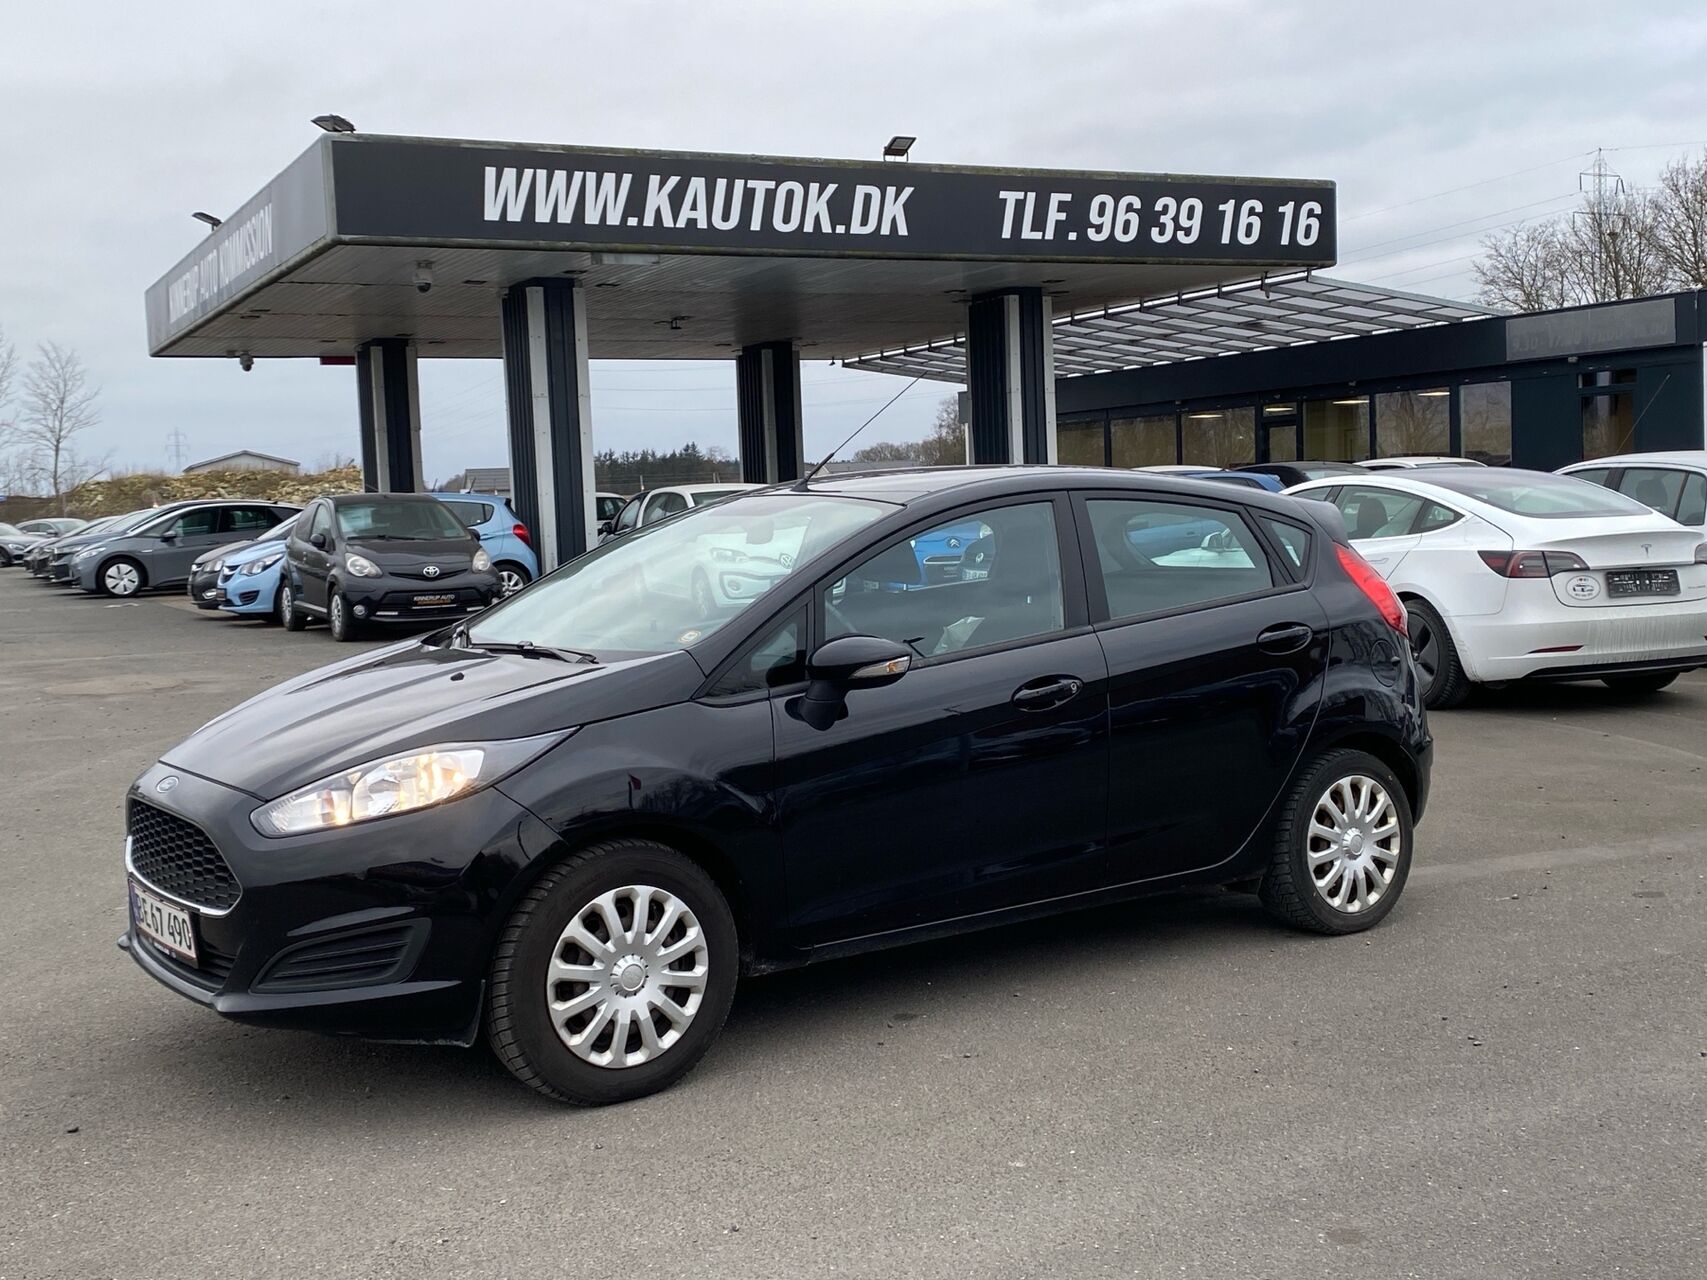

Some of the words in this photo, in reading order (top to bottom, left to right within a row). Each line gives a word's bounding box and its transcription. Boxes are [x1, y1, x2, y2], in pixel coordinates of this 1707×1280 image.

[483, 166, 915, 236] WWW.KAUTOK.DK
[998, 190, 1078, 241] TLF.
[1086, 193, 1142, 243] 96
[1150, 196, 1204, 244] 39
[1217, 199, 1264, 246] 16
[1277, 201, 1322, 247] 16
[150, 902, 164, 937] 67
[167, 912, 192, 951] 490
